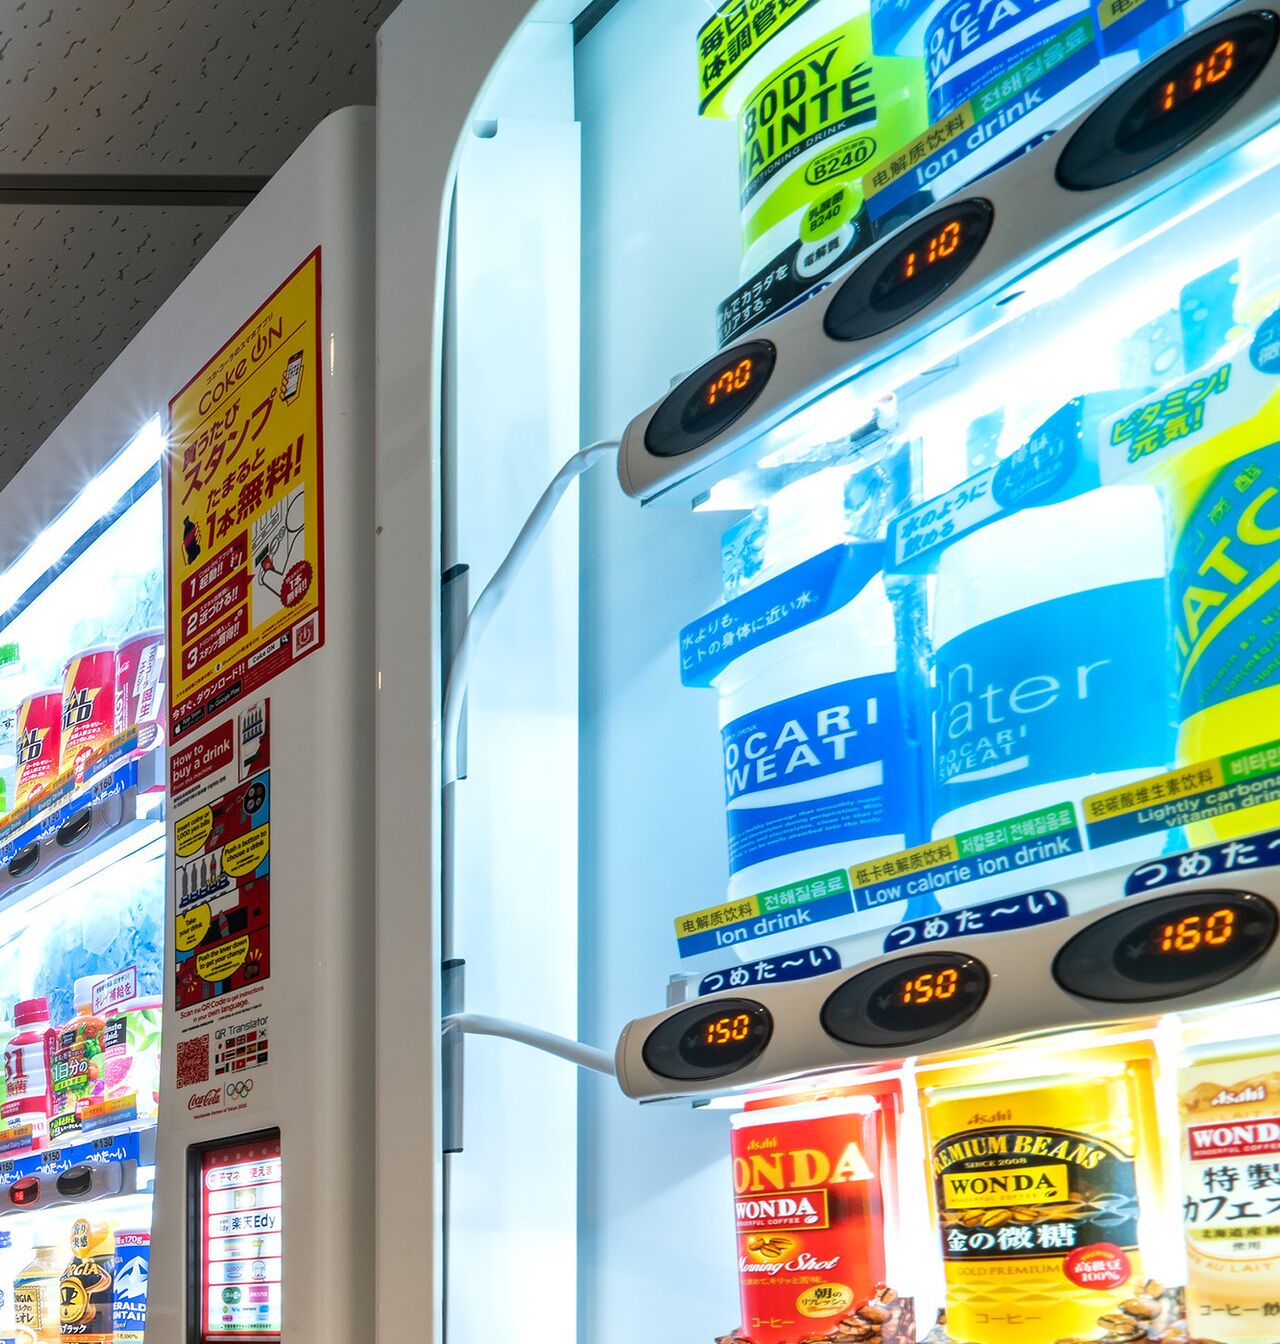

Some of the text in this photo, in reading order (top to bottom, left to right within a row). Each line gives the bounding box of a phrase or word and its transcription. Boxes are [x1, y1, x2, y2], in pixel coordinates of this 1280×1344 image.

[981, 26, 1088, 112] 전해질음료
[1162, 39, 1234, 112] 110
[743, 46, 840, 145] BODY
[743, 61, 875, 183] AINTÉ
[806, 121, 846, 147] DRINK
[916, 88, 1042, 186] Ion drink
[813, 146, 867, 180] B240
[872, 113, 965, 189] 电解质饮料
[810, 206, 840, 231] B240
[905, 220, 960, 276] 110
[1110, 363, 1231, 446] ビタミン!
[181, 387, 277, 506] スタンプ
[182, 397, 241, 472] 買うたび
[1128, 401, 1205, 463] 元気!
[207, 447, 265, 514] たまると
[207, 433, 305, 550] 1本無料!
[901, 481, 989, 538] 水のように
[187, 613, 197, 636] 2
[187, 647, 198, 671] 3
[725, 697, 878, 769] OCARI
[173, 743, 204, 770] How to
[173, 740, 230, 783] buy drink
[725, 732, 863, 797] WEAT
[1138, 798, 1200, 824] Lightly
[1166, 801, 1235, 828] vitamin
[856, 843, 952, 884] 低卡电解质饮料
[865, 837, 1072, 906] Low calorie ion drink
[764, 875, 845, 911] 전해질음료
[682, 902, 753, 933] 电解质饮料
[716, 908, 813, 946] Ion drink
[1158, 908, 1236, 953] 160
[902, 969, 958, 1005] 150
[215, 1015, 269, 1041] QR Translator
[706, 1015, 749, 1045] 150
[54, 1060, 88, 1082] 1日分の
[1211, 1086, 1265, 1106] Asahi
[968, 1109, 1012, 1124] Asahi
[43, 1152, 60, 1163] ¥150
[747, 1137, 777, 1151] Asahi
[1014, 1135, 1106, 1169] BEANS
[733, 1142, 874, 1194] ONDA
[998, 1158, 1027, 1167] 2008
[951, 1173, 1055, 1195] WONDA
[768, 1218, 801, 1226] COFFEE
[947, 1223, 1077, 1252] 金の微糖
[1233, 1241, 1260, 1251] 使用
[785, 1253, 840, 1272] Shot
[957, 1265, 1059, 1276] GOLD PREMIUM
[1074, 1261, 1121, 1273] 高級豆
[1081, 1272, 1119, 1282] 100%
[814, 1287, 842, 1299] 朝の
[752, 1317, 795, 1328] コーヒー
[975, 1313, 1043, 1324] コーヒー
